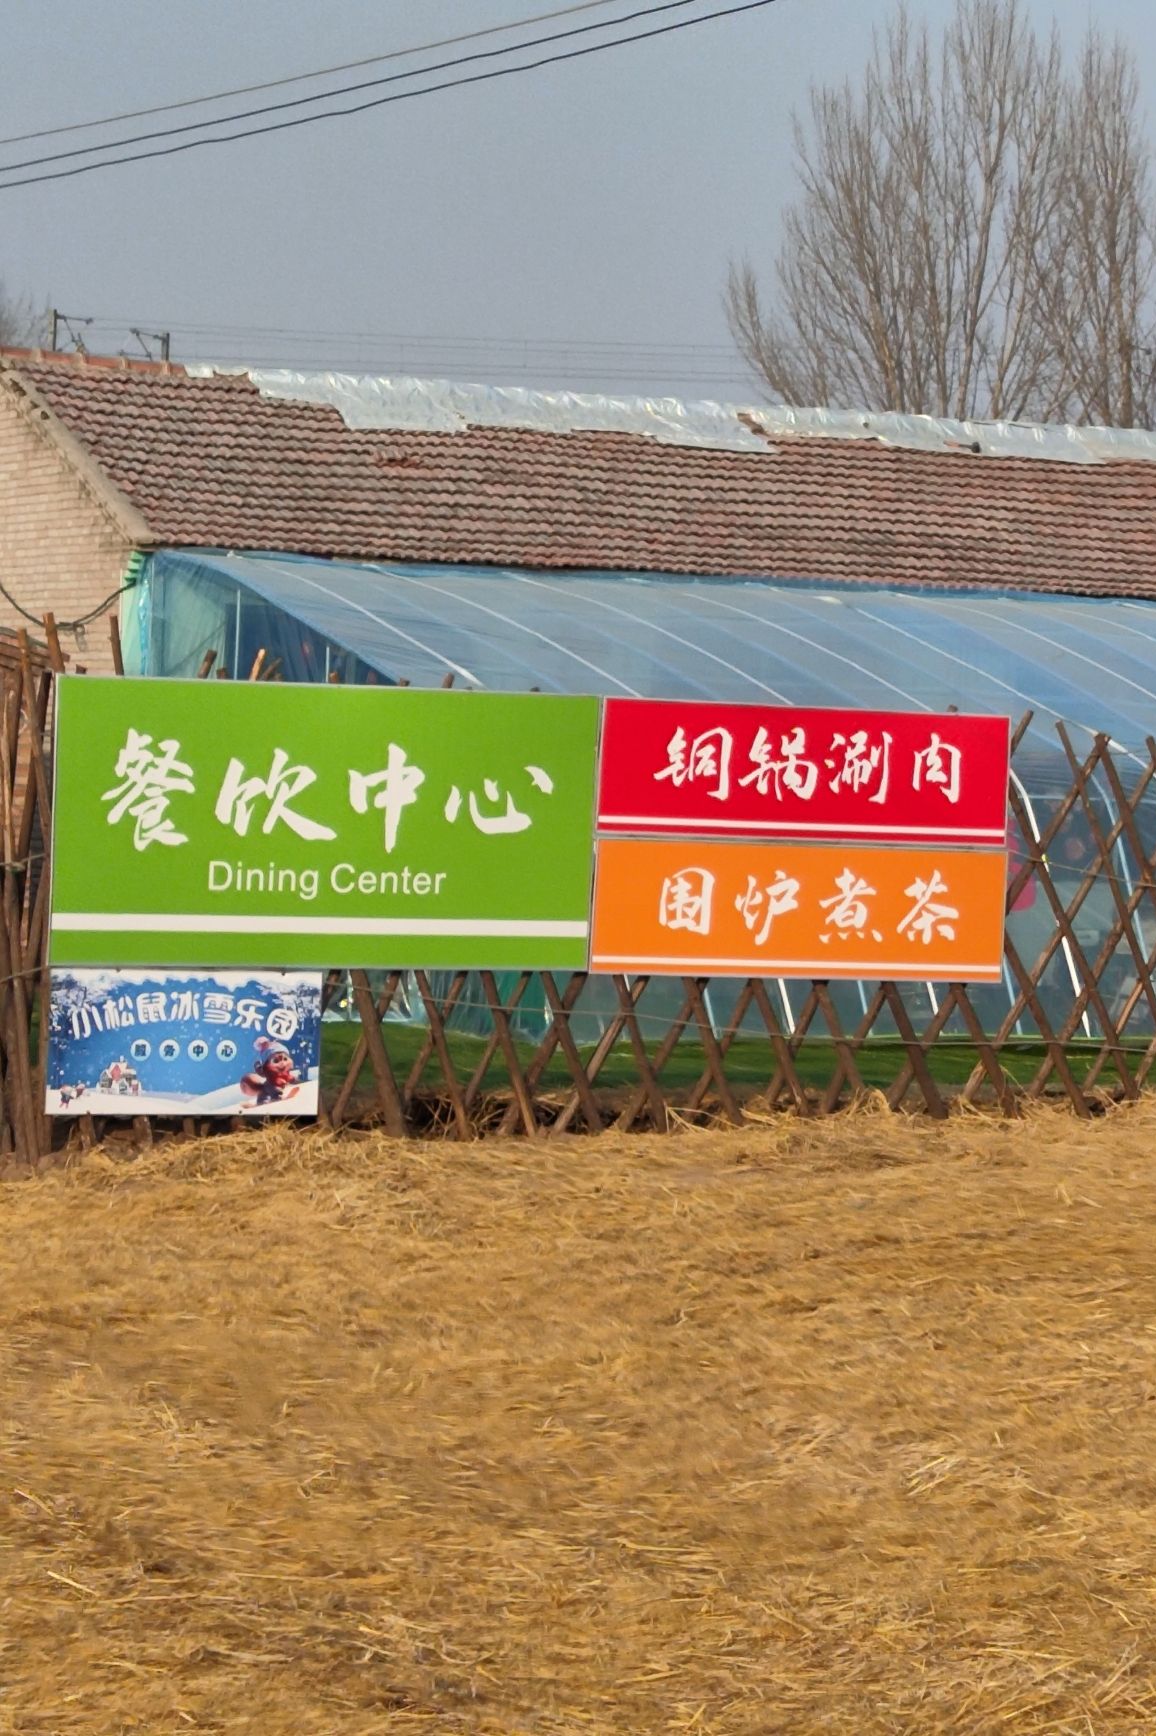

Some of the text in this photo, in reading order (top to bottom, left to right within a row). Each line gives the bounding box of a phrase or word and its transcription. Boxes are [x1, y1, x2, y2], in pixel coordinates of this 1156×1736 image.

[101, 728, 554, 853] 餐饮中心
[653, 726, 962, 804] 铜锅涮肉
[208, 861, 446, 899] Dining Center
[659, 867, 960, 945] 围炉煮茶
[71, 990, 298, 1041] 小松鼠冰雪乐园
[133, 1042, 234, 1058] 服务中心
